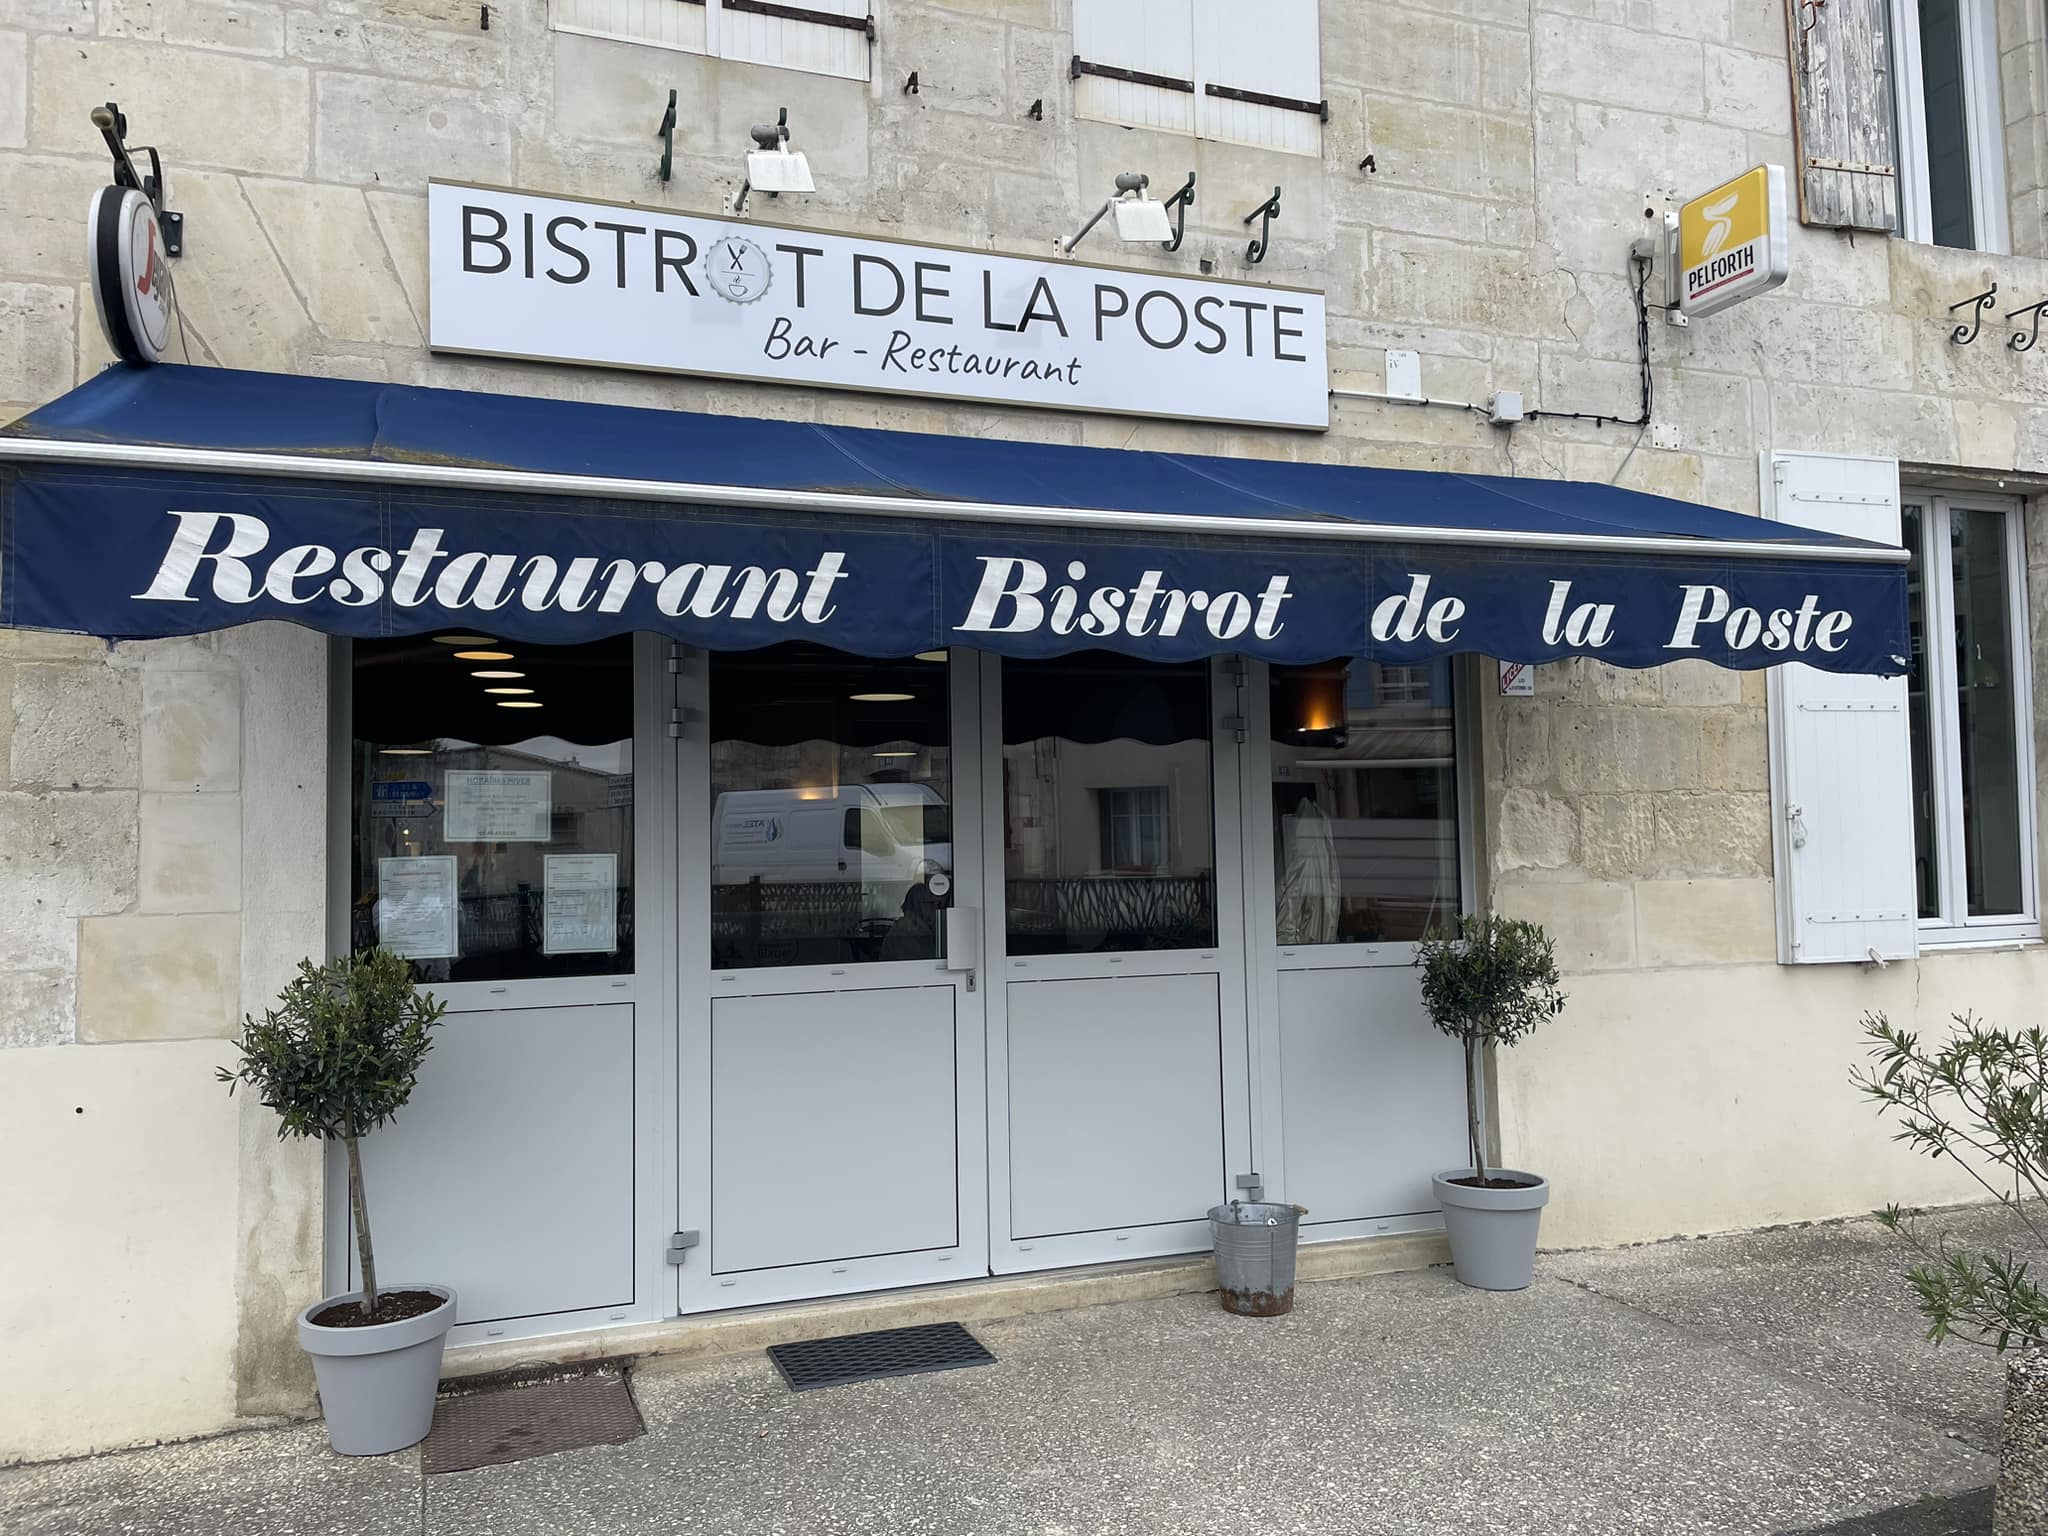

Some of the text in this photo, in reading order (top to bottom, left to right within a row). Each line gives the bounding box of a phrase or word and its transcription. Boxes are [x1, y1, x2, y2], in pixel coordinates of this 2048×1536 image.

[854, 254, 953, 324] DE
[984, 271, 1068, 337] LA
[1095, 284, 1305, 361] POSTE
[1688, 245, 1754, 292] PELFORTH
[764, 318, 838, 359] Bar
[882, 331, 1081, 385] Restaurant
[131, 511, 1852, 651] Restaurant Bistrot de la Poste
